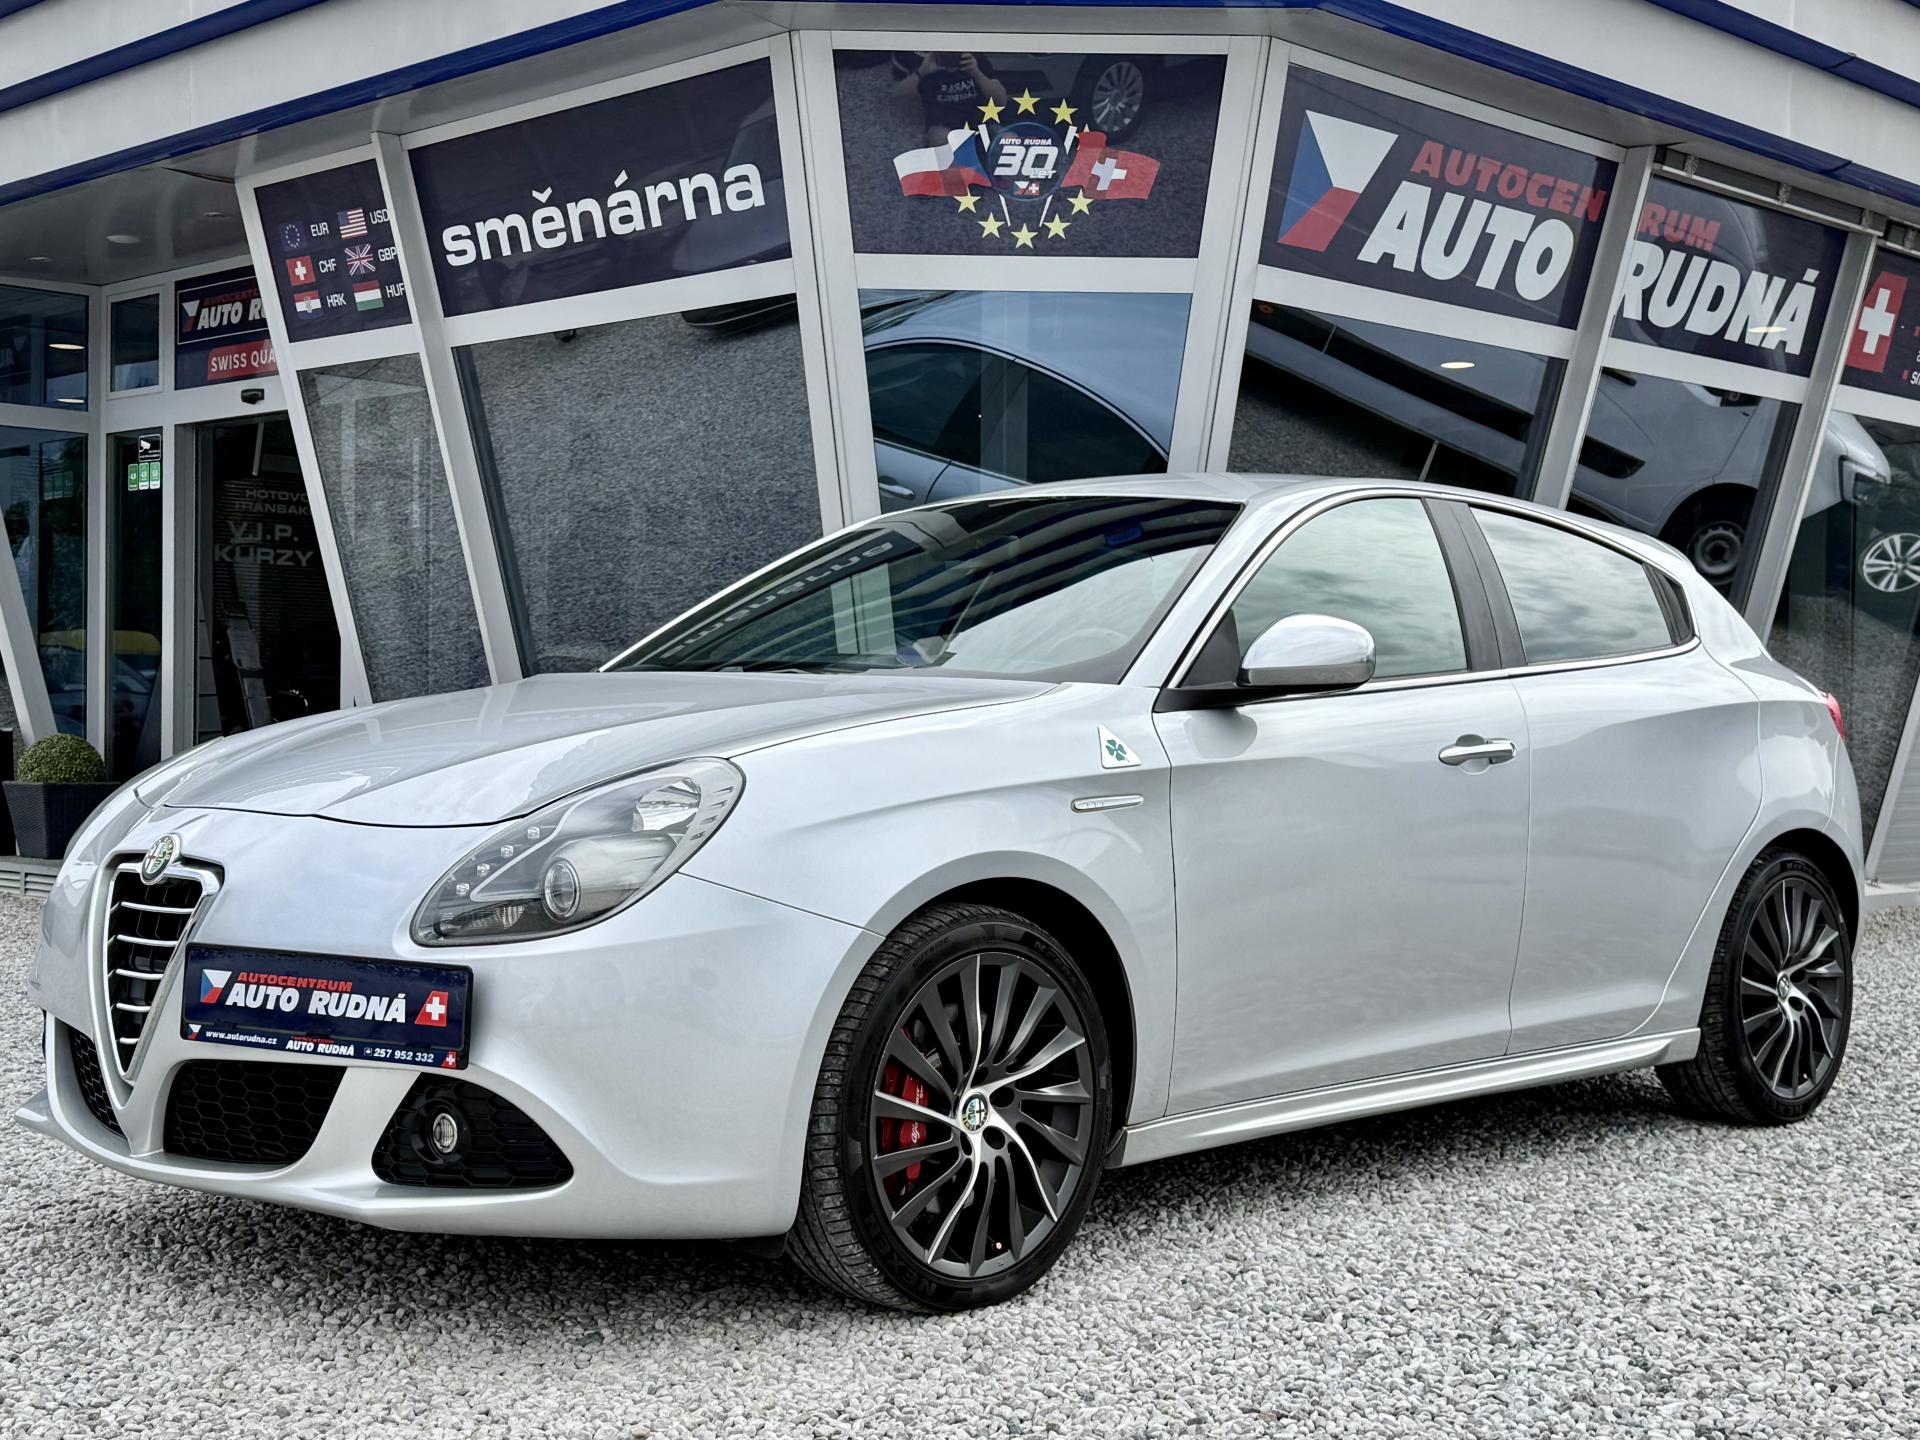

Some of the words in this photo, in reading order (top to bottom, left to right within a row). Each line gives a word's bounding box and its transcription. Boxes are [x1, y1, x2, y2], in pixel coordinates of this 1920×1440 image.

[994, 145, 1059, 176] 30
[369, 208, 390, 225] USD
[442, 163, 766, 267] směnárna
[310, 222, 330, 237] EUR
[377, 246, 398, 262] GBP
[318, 258, 337, 273] CHF
[1357, 180, 1575, 301] AUTO
[1614, 240, 1820, 356] RUDNÁ
[385, 283, 405, 298] HUF
[326, 293, 347, 308] HRK
[197, 301, 243, 330] AUTO
[211, 352, 247, 372] SWISS
[234, 501, 312, 516] TRANSAK
[214, 543, 314, 567] KURZY
[237, 971, 353, 992] AUTOCENTRUM
[225, 983, 300, 1013] AUTO
[308, 991, 406, 1023] RUDNÁ
[205, 1030, 278, 1045] www.autorudna.cz
[285, 1040, 315, 1052] AUTO
[317, 1043, 355, 1056] RUDNÁ
[373, 1047, 392, 1058] 257
[394, 1050, 413, 1060] 952
[415, 1052, 435, 1063] 332
